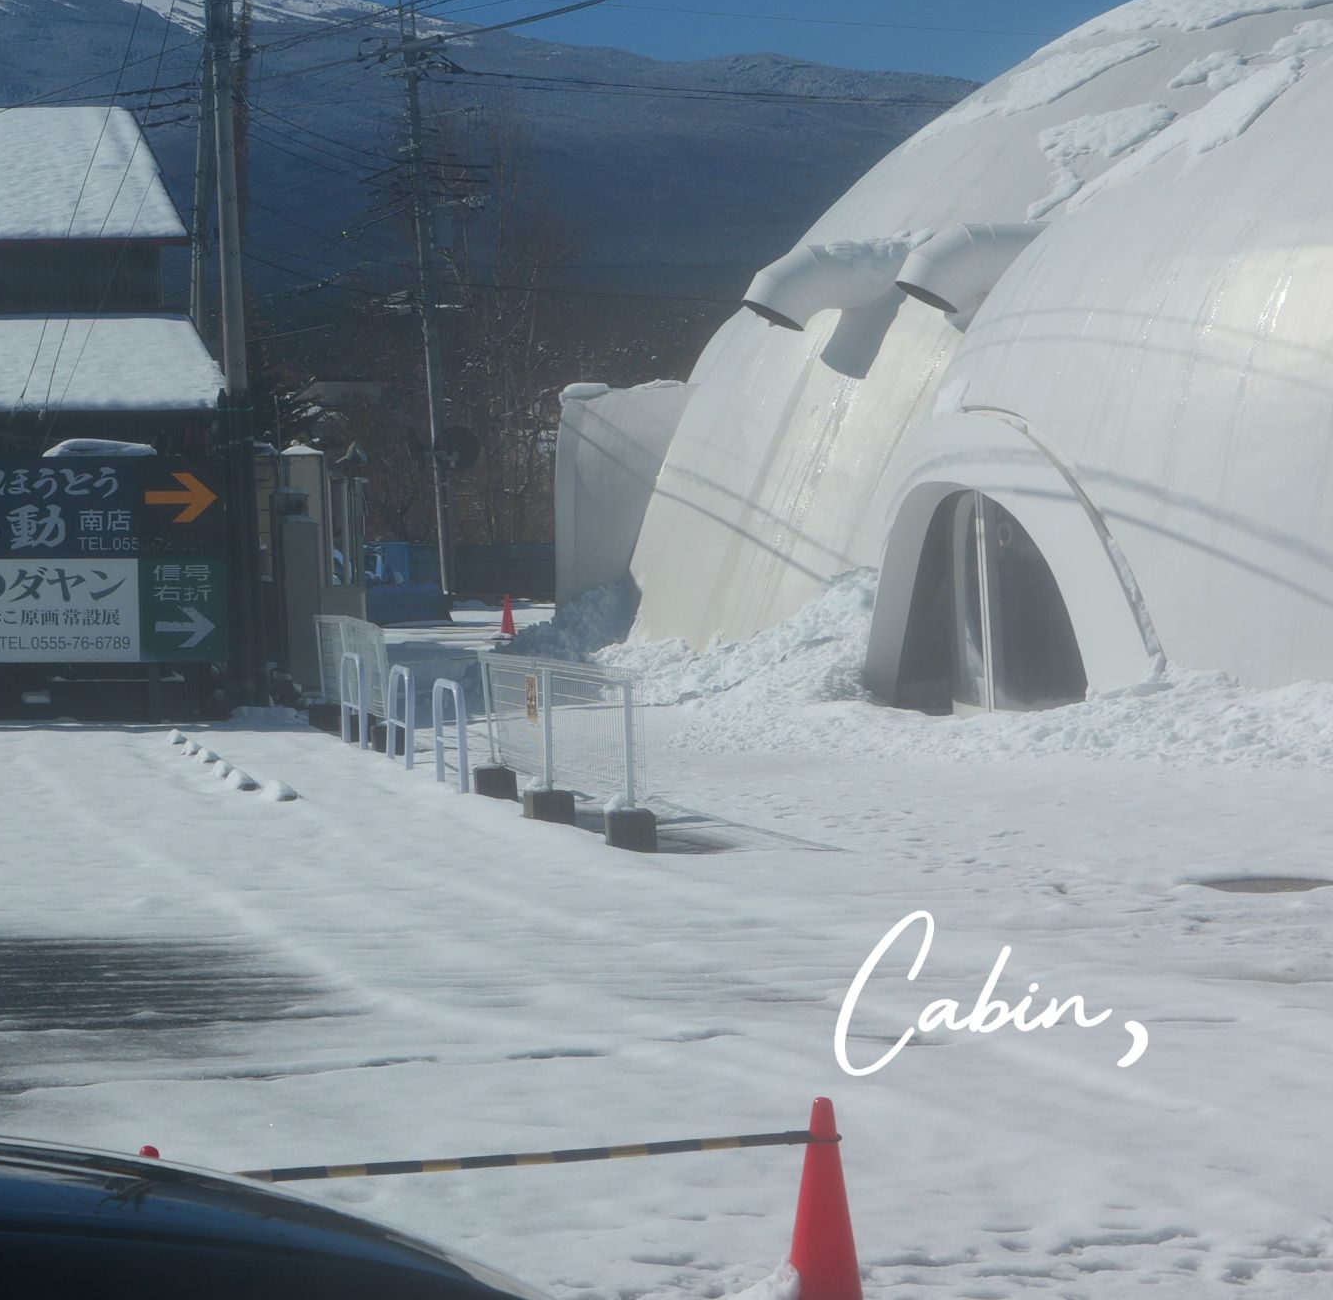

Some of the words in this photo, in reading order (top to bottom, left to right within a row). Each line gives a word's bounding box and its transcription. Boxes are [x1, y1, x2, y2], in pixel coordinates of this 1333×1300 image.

[78, 508, 132, 532] 南店
[153, 564, 212, 582] 信号
[153, 584, 213, 602] 右折
